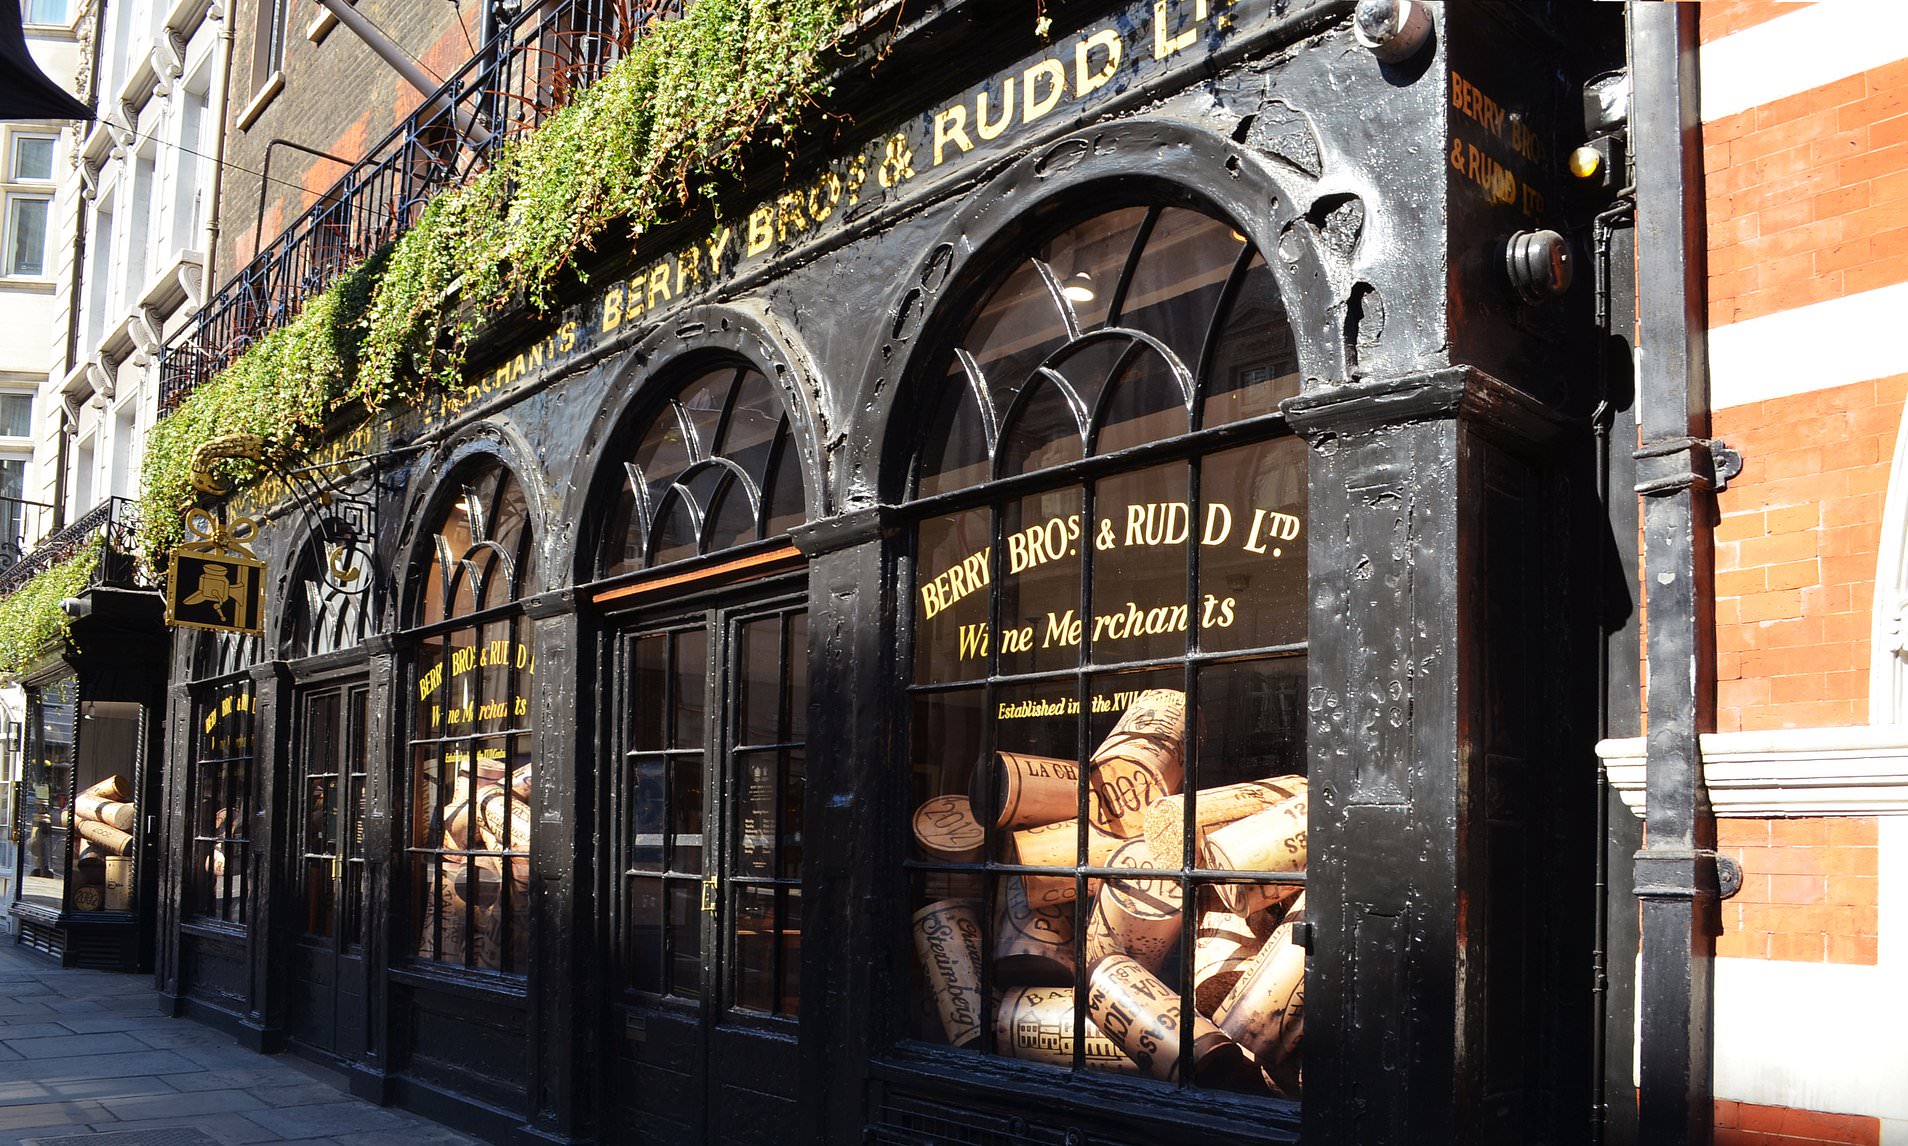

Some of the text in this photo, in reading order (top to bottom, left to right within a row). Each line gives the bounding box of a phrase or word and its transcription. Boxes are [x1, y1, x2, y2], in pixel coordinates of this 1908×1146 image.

[1451, 71, 1505, 138] BERRY
[602, 228, 731, 332] BERRY
[878, 133, 916, 189] &
[933, 28, 1123, 166] RUDD
[1450, 138, 1466, 174] &
[1468, 143, 1516, 205] RUDD
[921, 546, 991, 620] BERRY
[1096, 519, 1116, 551] &
[1125, 502, 1232, 547] RUDD
[959, 594, 1236, 662] Wine Merchants
[419, 662, 443, 701] BERR
[480, 648, 487, 667] &
[431, 695, 527, 728] Wne Mrchats
[998, 698, 1065, 720] Established
[1068, 699, 1081, 715] in
[1092, 694, 1111, 713] the
[1024, 760, 1050, 778] LA
[924, 802, 983, 845] 2012
